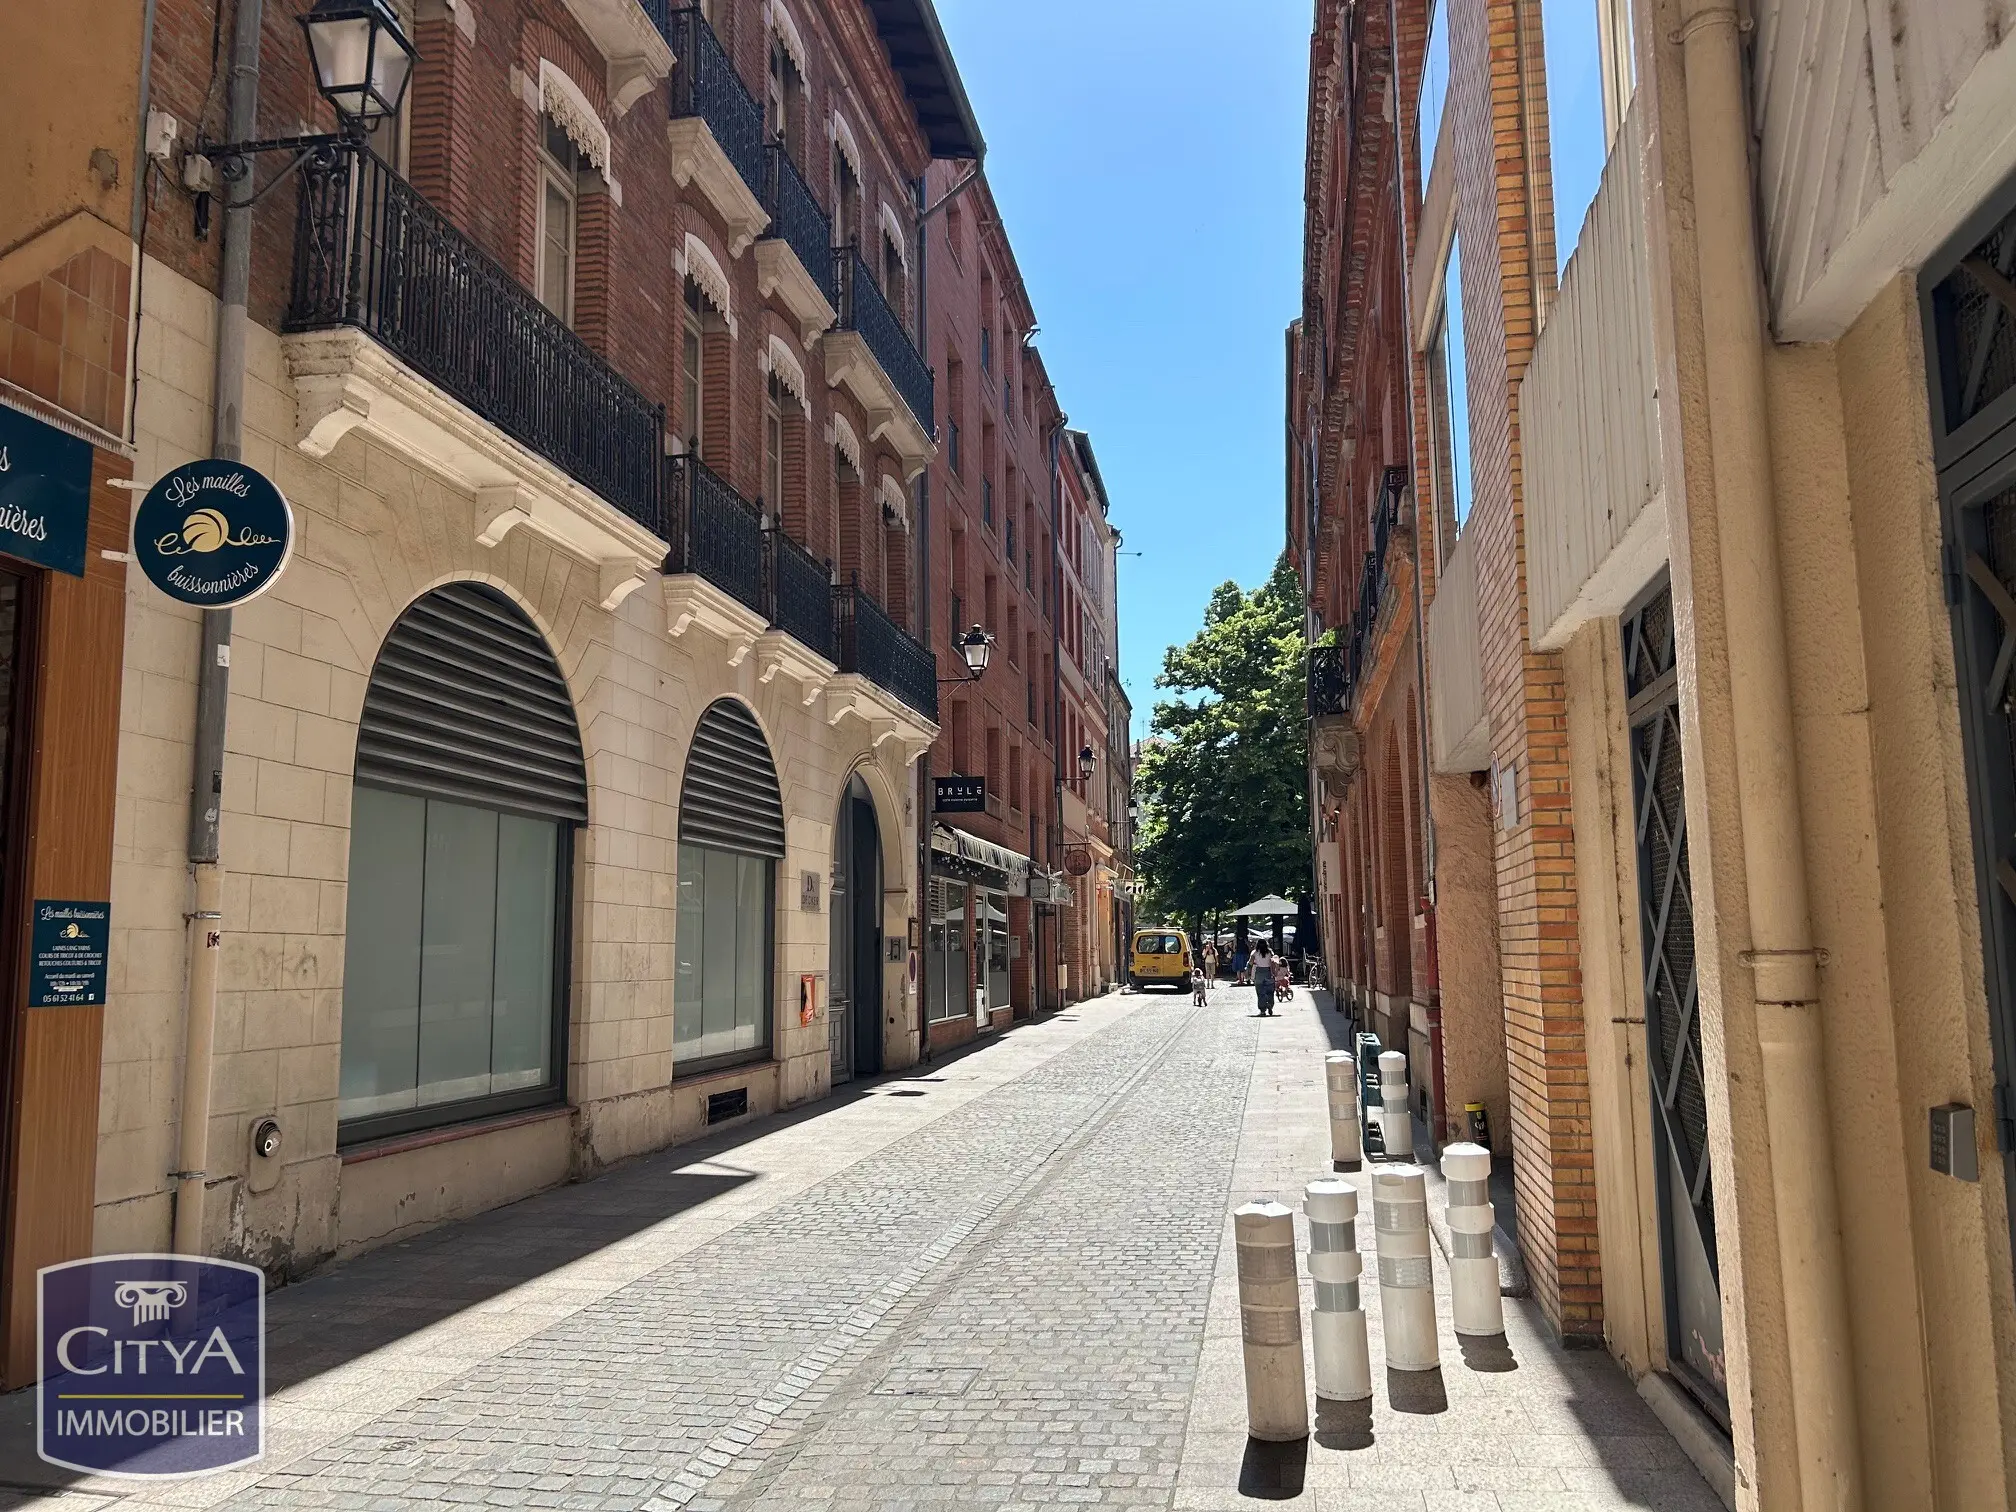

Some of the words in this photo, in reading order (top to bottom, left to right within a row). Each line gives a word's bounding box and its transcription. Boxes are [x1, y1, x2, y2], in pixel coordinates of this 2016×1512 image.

[165, 476, 200, 507] Les
[202, 472, 251, 498] mailles
[167, 562, 259, 594] buissonnières
[40, 905, 54, 920] Les
[43, 994, 51, 1002] 05
[60, 994, 67, 1002] 52
[76, 993, 84, 1001] 64
